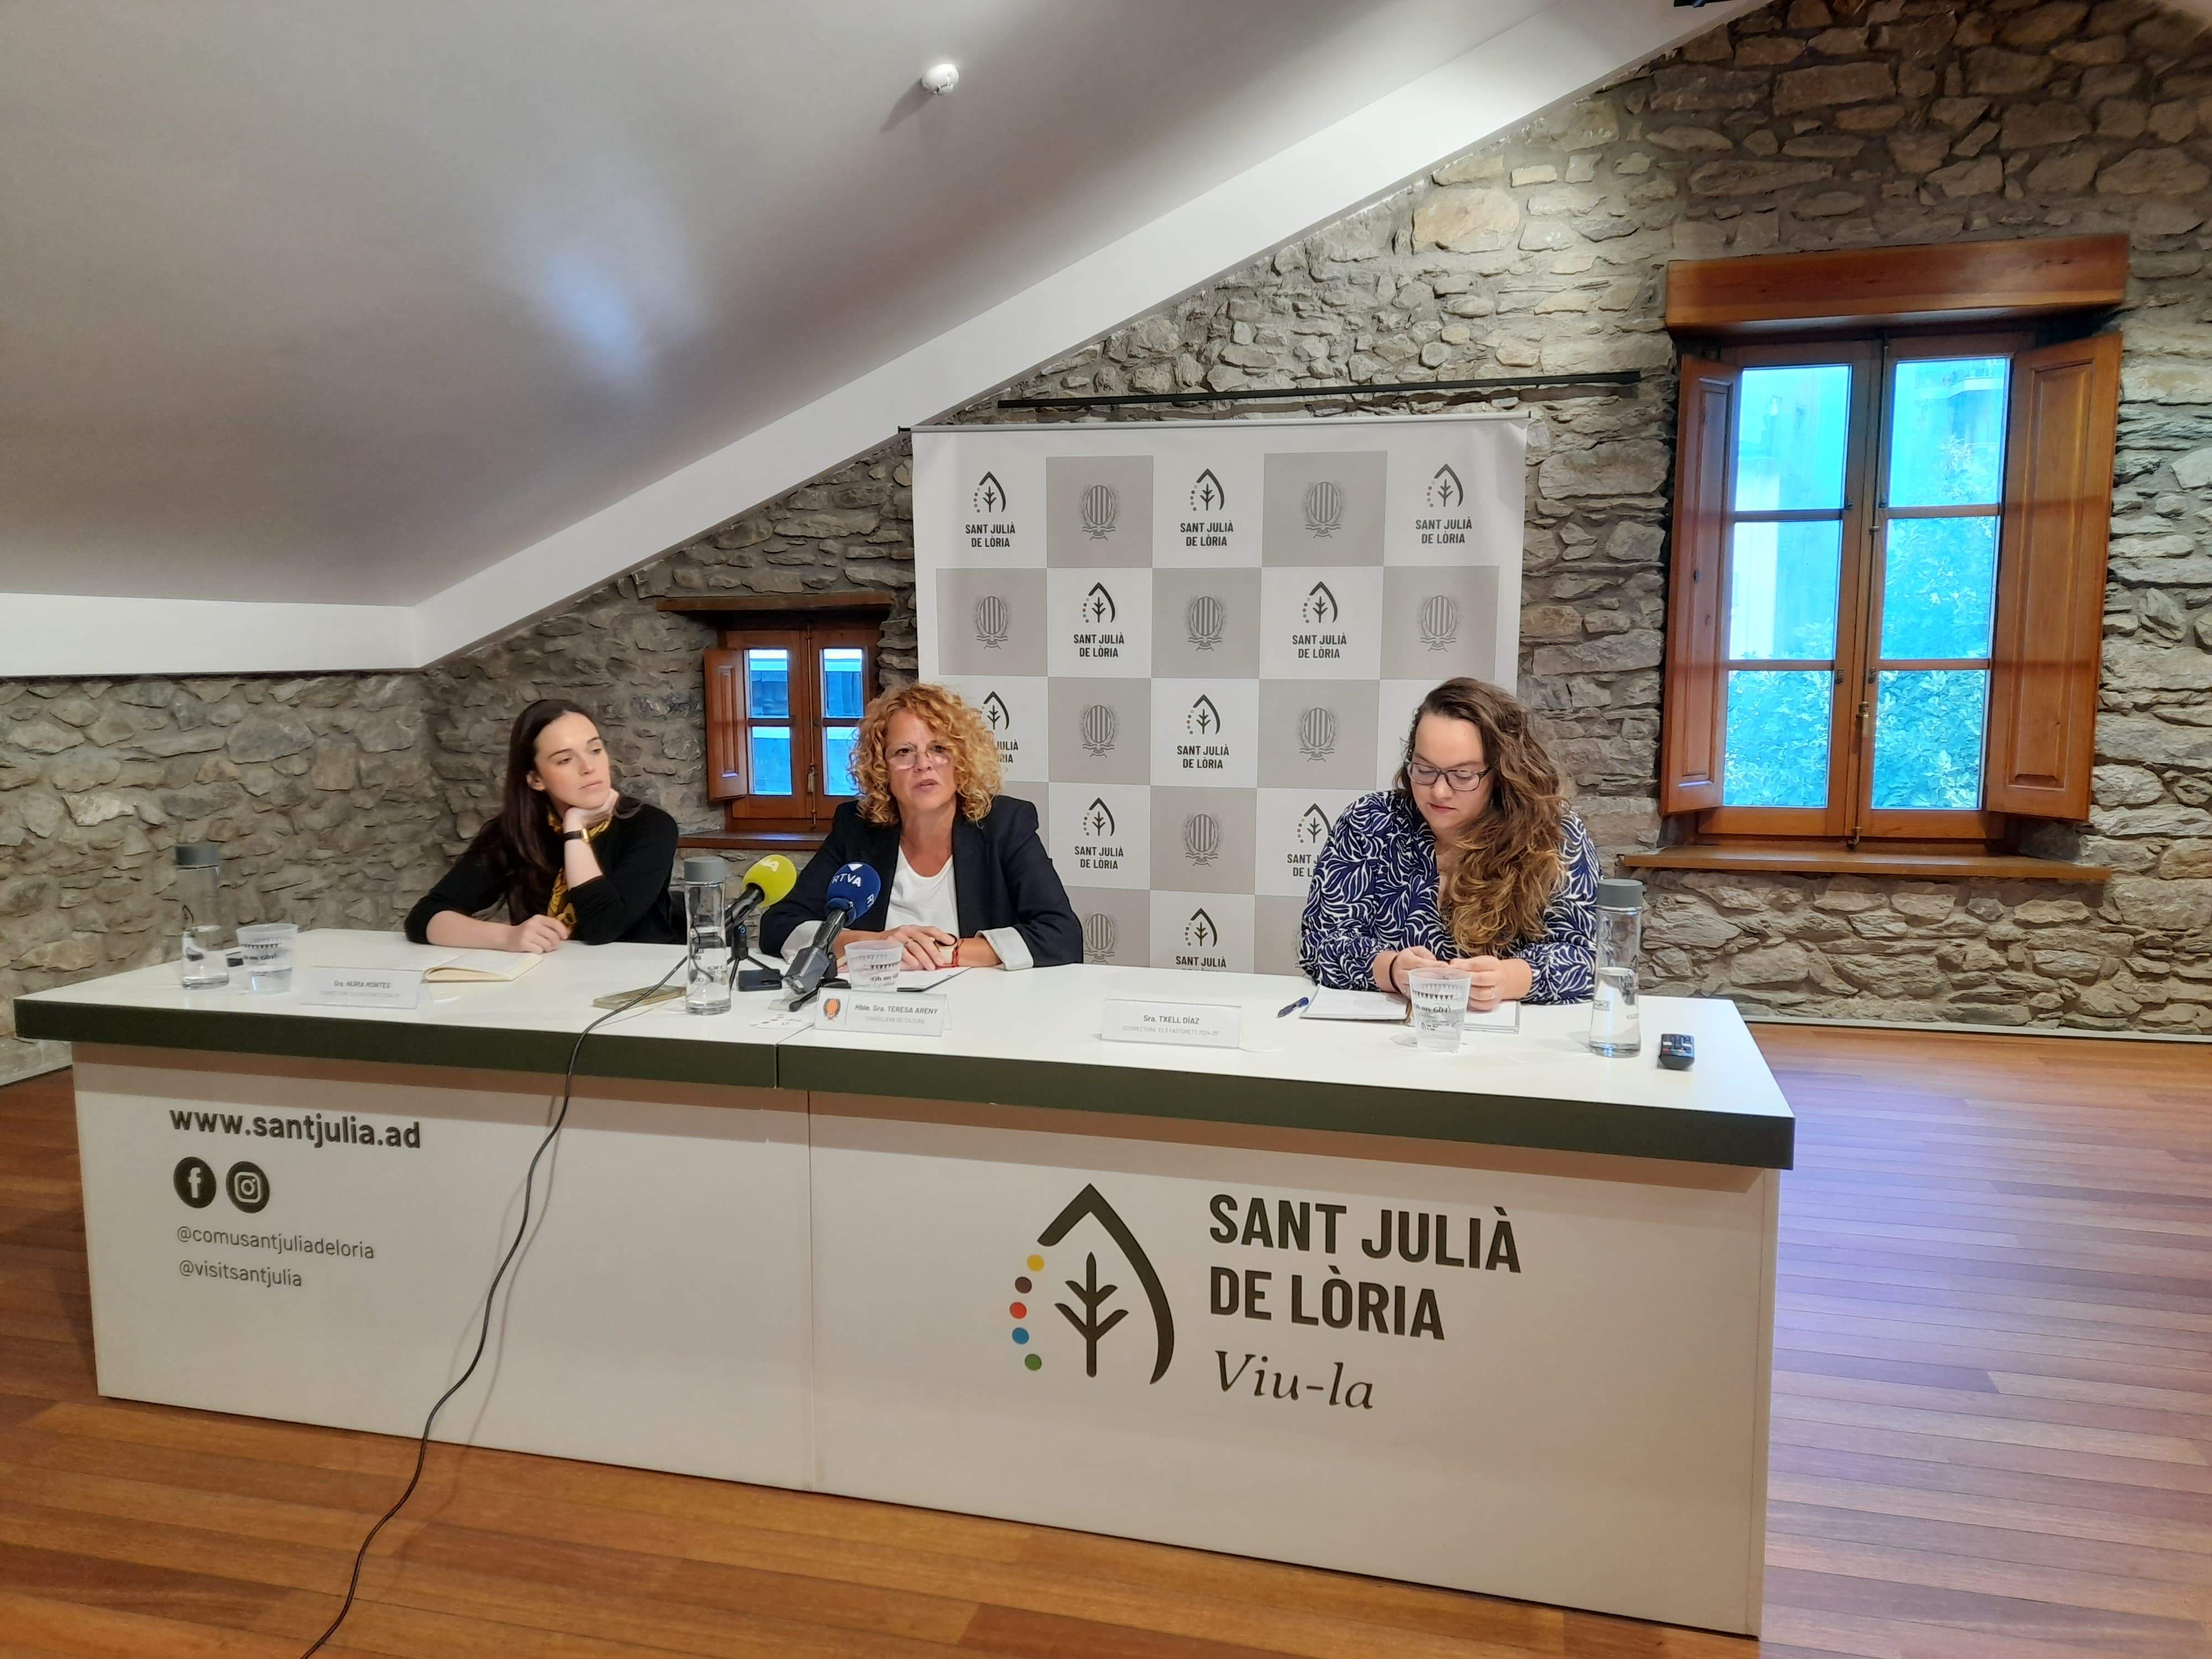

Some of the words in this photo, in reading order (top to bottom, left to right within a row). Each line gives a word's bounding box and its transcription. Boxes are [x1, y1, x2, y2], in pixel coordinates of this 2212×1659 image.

[966, 524, 988, 534] SANT
[990, 522, 1015, 534] JULIÀ
[1181, 523, 1204, 533] SANT
[1207, 520, 1233, 532] JULIÀ
[1416, 520, 1442, 529] SANT
[1444, 517, 1472, 529] JULIÀ
[972, 538, 982, 547] DE
[985, 535, 1010, 547] LÒRIA
[1186, 537, 1197, 546] DE
[1201, 534, 1227, 546] LÒRIA
[1422, 534, 1433, 544] DE
[1437, 531, 1465, 544] LÒRIA
[1074, 634, 1097, 644] SANT
[1099, 633, 1124, 644] JULIÀ
[1293, 635, 1317, 644] SANT
[1319, 633, 1347, 644] JULIÀ
[1079, 648, 1090, 657] DE
[1093, 645, 1118, 657] LÒRIA
[1298, 649, 1310, 658] DE
[1313, 646, 1340, 658] LÒRIA
[1177, 745, 1201, 755] SANT
[1203, 744, 1229, 755] JULIÀ
[1183, 759, 1194, 768] DE
[1197, 757, 1223, 769] LÒRIA
[1075, 846, 1097, 855] SANT
[1099, 846, 1123, 857] JULIÀ
[1081, 859, 1091, 868] DE
[1094, 858, 1118, 869] LÒRIA
[1287, 854, 1311, 863] SANT
[1293, 867, 1304, 877] DE
[831, 873, 862, 888] RTVA
[1176, 956, 1199, 966] SANT
[1201, 957, 1226, 968] JULIÀ
[1183, 1015, 1199, 1025] DÍAZ
[170, 1110, 420, 1148] www.santjulia.ad
[1209, 1193, 1347, 1254] SANT
[1361, 1206, 1521, 1274] JULIÀ
[178, 1227, 373, 1259] @comusantjuliadeloria
[179, 1259, 302, 1287] @visitsantjulia
[1210, 1266, 1272, 1321] DE
[1291, 1265, 1445, 1340] LÒRIA
[1215, 1349, 1374, 1410] Viu-la
